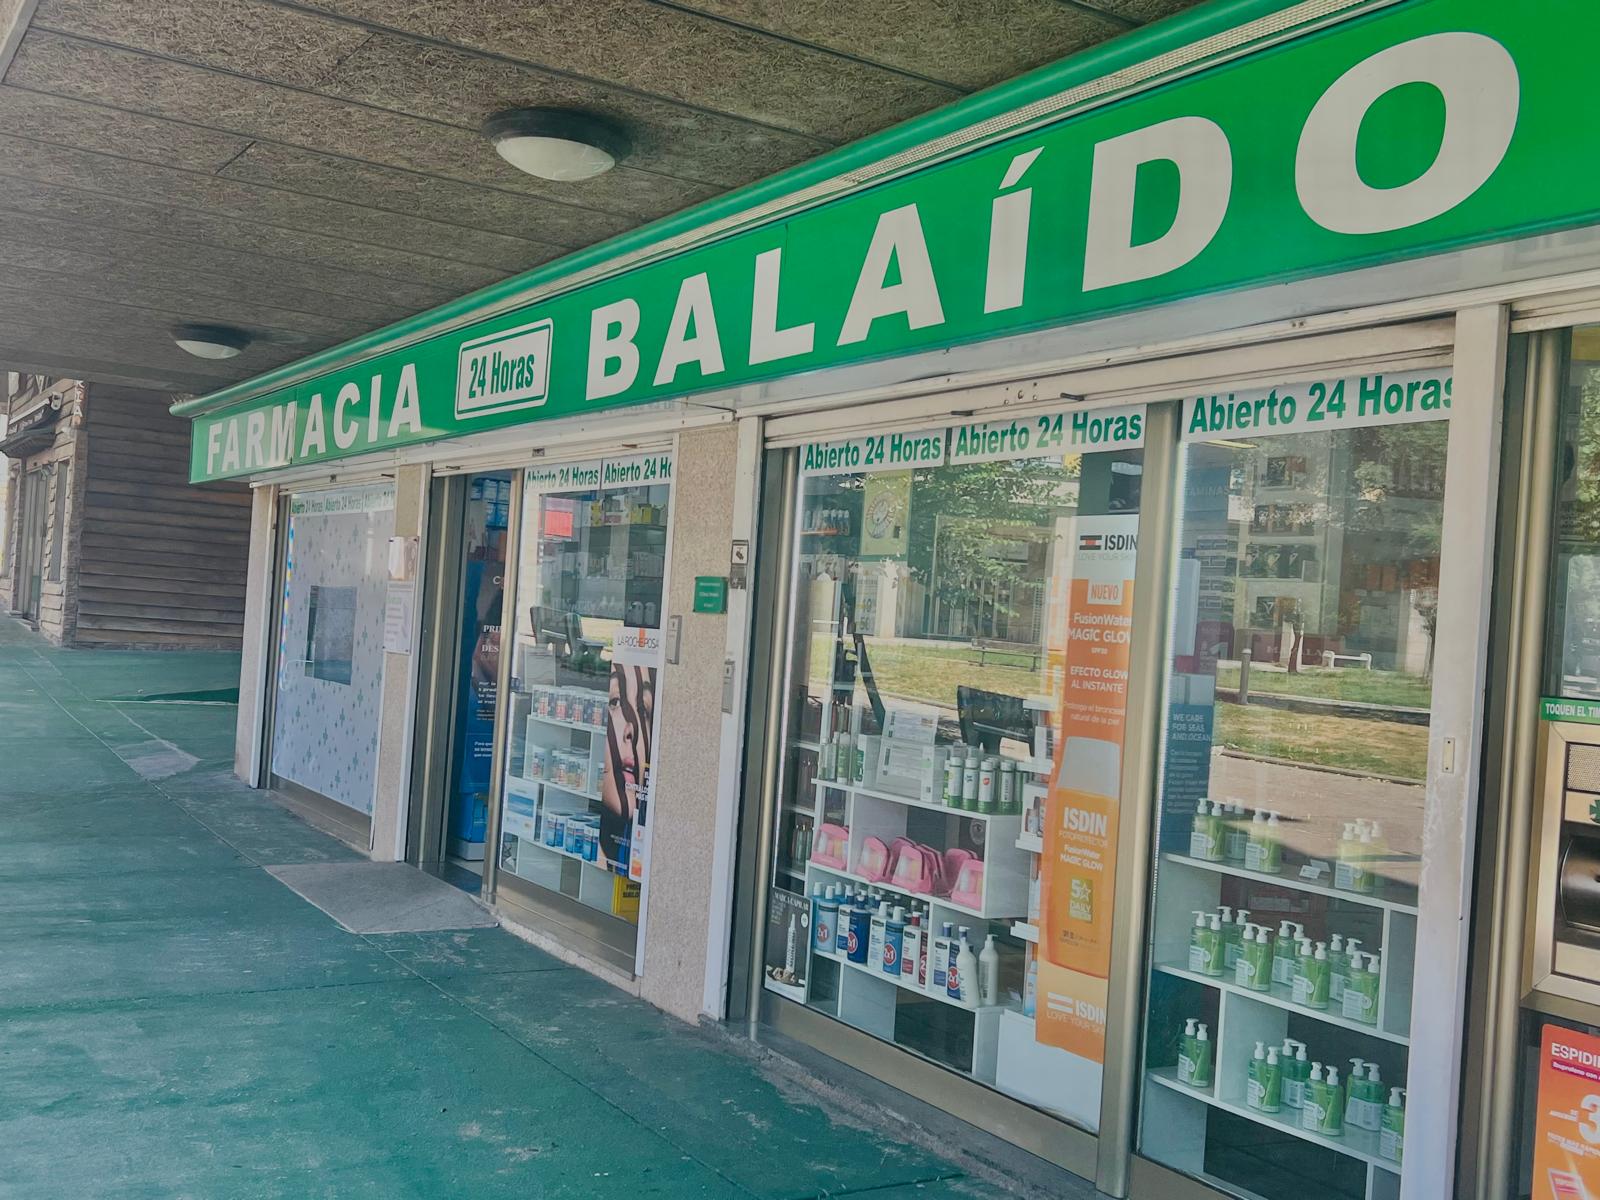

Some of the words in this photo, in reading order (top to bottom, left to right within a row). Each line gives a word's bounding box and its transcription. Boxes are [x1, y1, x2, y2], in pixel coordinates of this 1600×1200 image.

[586, 32, 1520, 400] BALAÍDO
[468, 351, 487, 399] 24
[490, 350, 535, 395] Horas
[1188, 388, 1297, 434] Abierto
[1306, 379, 1346, 422] 24
[1357, 374, 1453, 417] Horas
[206, 362, 423, 475] FARMACIA
[954, 424, 1030, 458] Abierto
[1037, 414, 1064, 447] 24
[1071, 411, 1143, 446] Horas
[803, 442, 860, 471] Abierto
[865, 436, 885, 466] 24
[888, 433, 942, 463] Horas
[558, 467, 571, 487] 24
[572, 466, 600, 486] Horas
[603, 461, 641, 485] Abierto
[643, 458, 657, 480] 24
[1104, 534, 1137, 551] ISDIN
[1091, 584, 1119, 601] NUEVO
[1068, 626, 1101, 642] MAGIC
[1070, 665, 1101, 677] EFECTO
[1103, 668, 1128, 680] GLOW
[1071, 680, 1081, 689] AL
[1082, 681, 1124, 694] INSTANTE
[1545, 703, 1576, 717] TOQUEN
[1577, 705, 1586, 717] EL
[1063, 807, 1108, 838] ISDIN
[1075, 999, 1106, 1025] ISDIN
